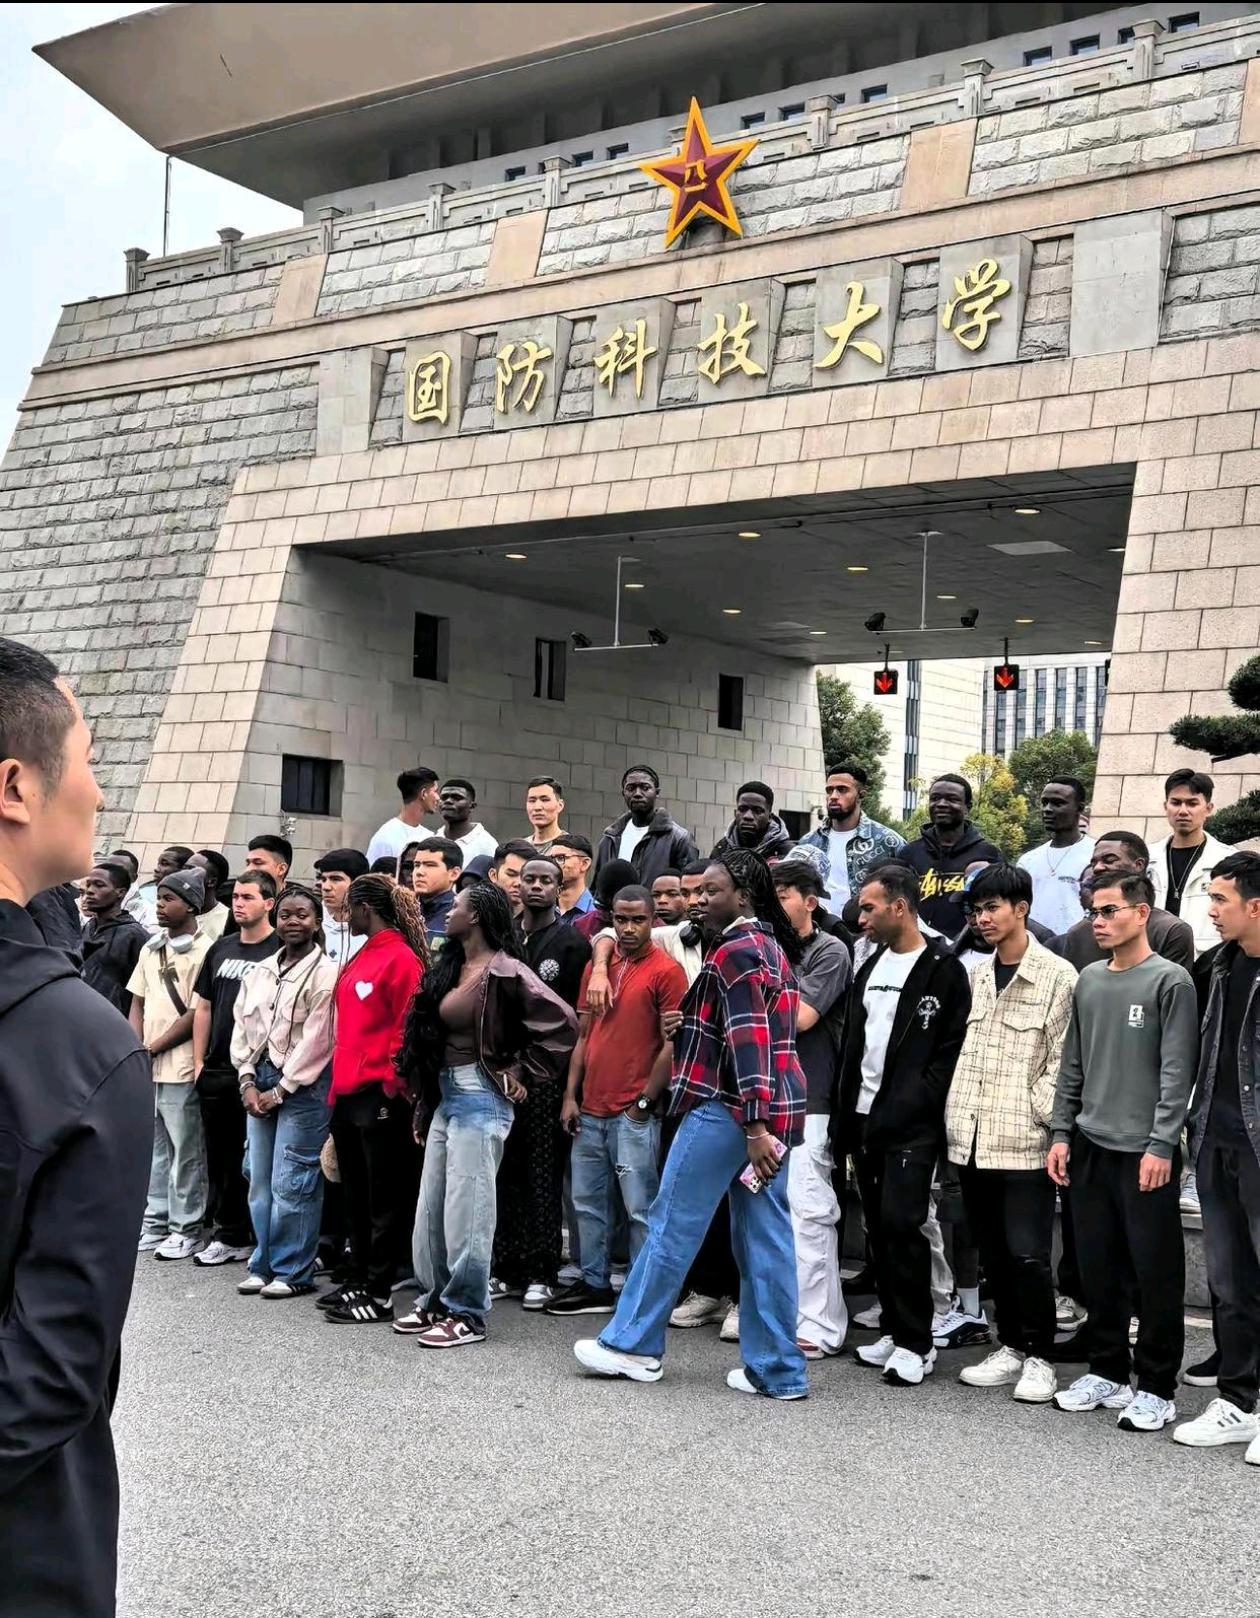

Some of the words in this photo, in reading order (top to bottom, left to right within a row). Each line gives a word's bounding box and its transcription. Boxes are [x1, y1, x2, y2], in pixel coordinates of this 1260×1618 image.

[407, 258, 1012, 426] 国防科技大学
